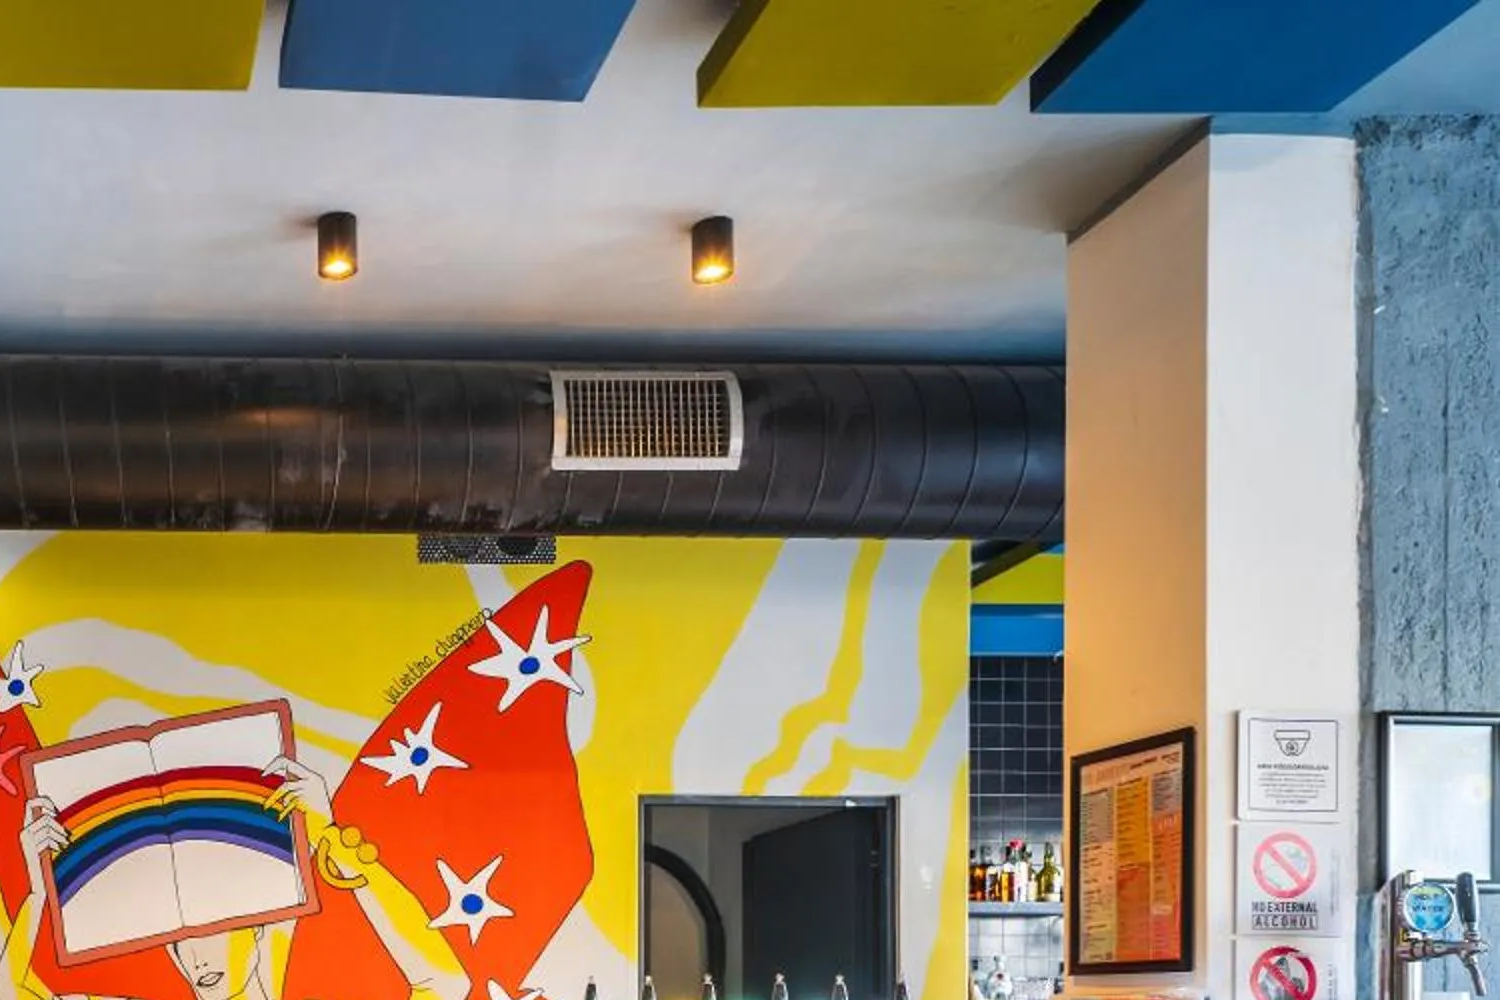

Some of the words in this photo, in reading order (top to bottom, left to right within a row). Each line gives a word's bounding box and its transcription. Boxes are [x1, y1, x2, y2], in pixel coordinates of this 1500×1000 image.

[1252, 902, 1266, 912] NO
[1268, 902, 1318, 913] EXTERNAL
[1255, 915, 1315, 927] ALCOHOL
